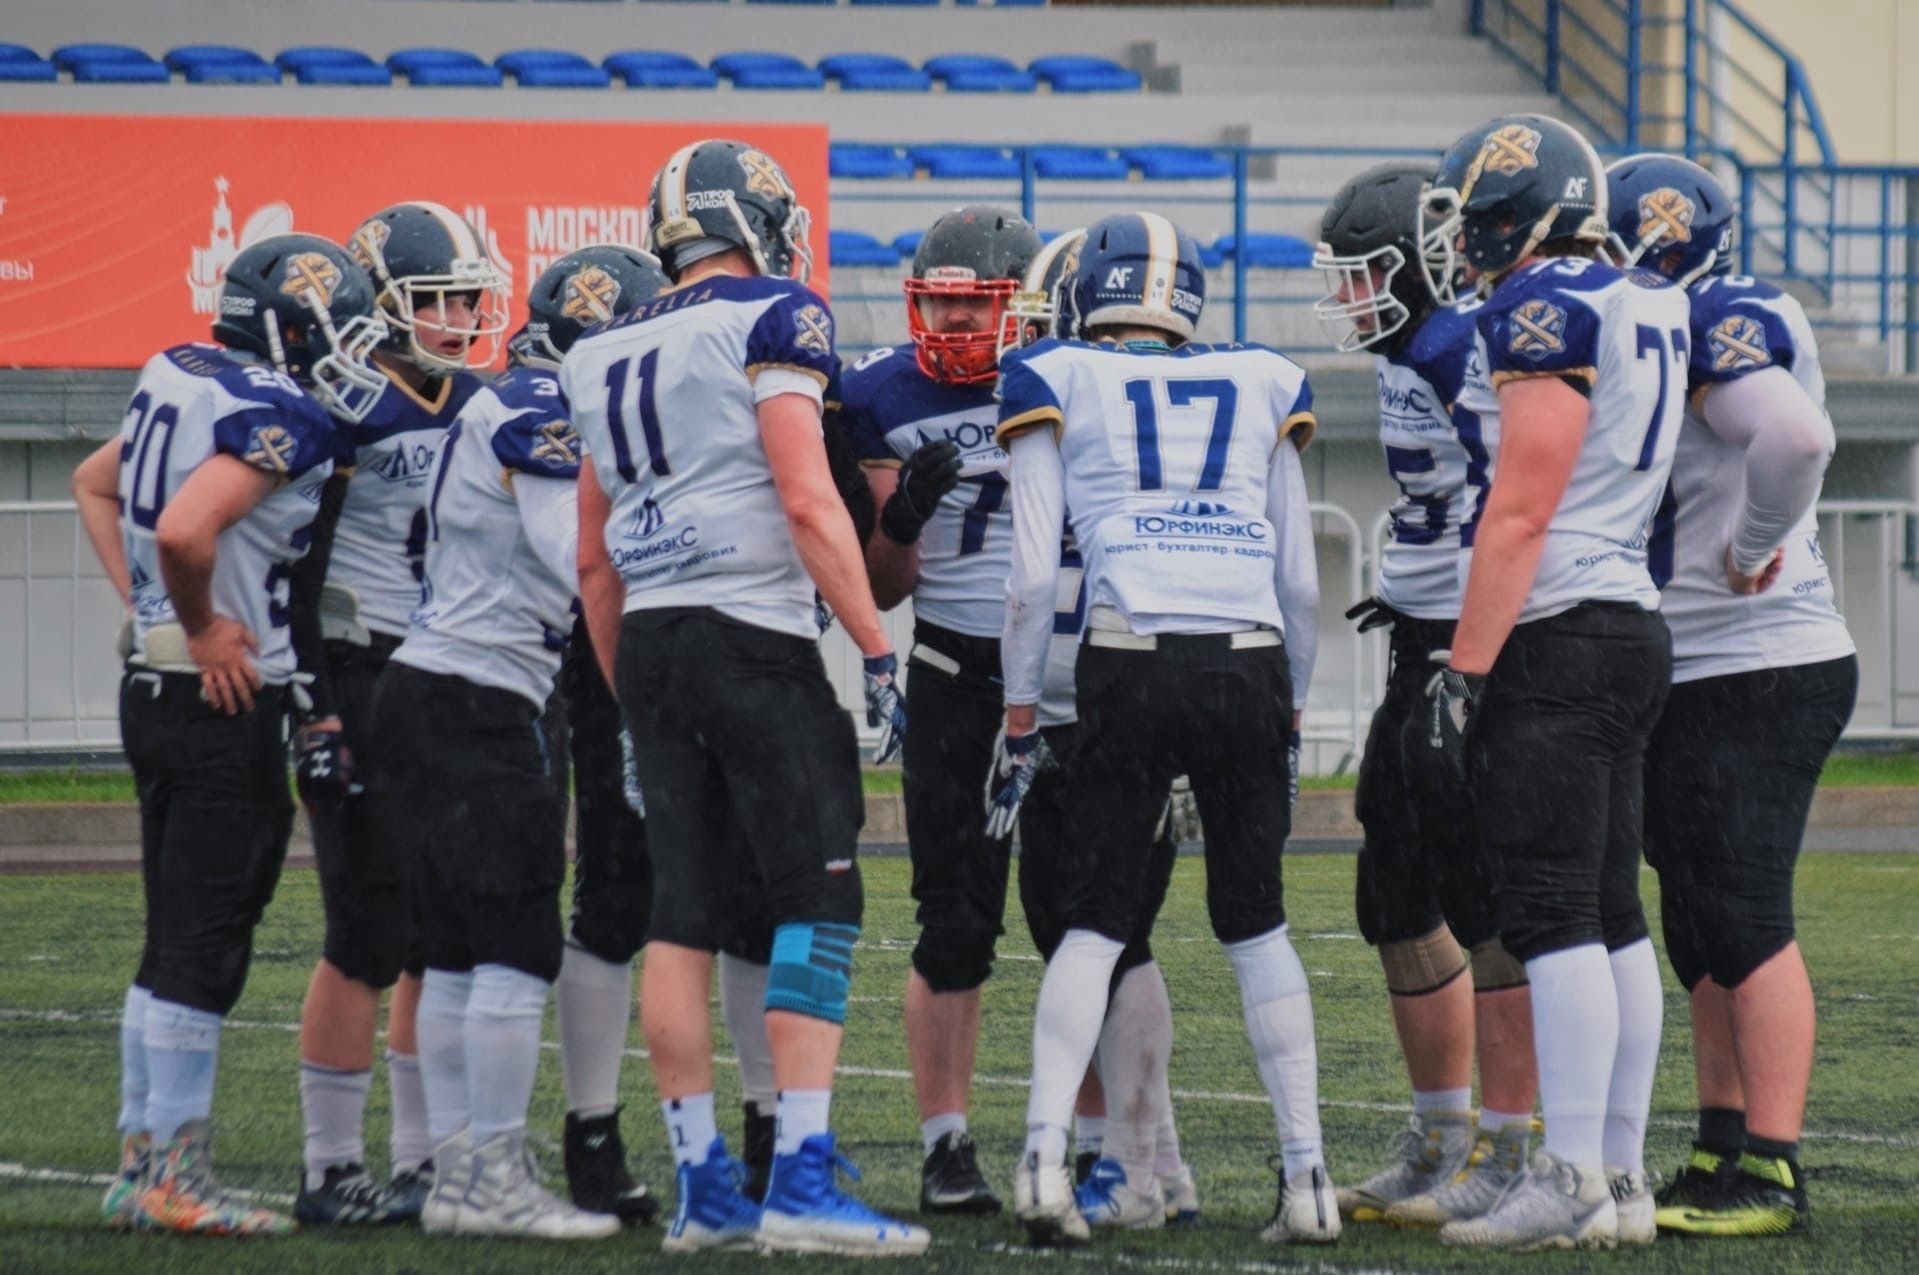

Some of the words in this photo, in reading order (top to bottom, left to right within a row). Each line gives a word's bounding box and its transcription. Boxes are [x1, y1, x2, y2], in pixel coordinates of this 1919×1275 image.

[1564, 177, 1588, 199] AF
[528, 206, 652, 251] МОСКО
[1104, 267, 1134, 289] AF
[604, 346, 673, 485] 11
[1122, 376, 1239, 493] 17
[1135, 516, 1267, 540] ЮРФИНЭКС
[1105, 542, 1149, 556] юрист
[1157, 541, 1229, 556] бухгалтер
